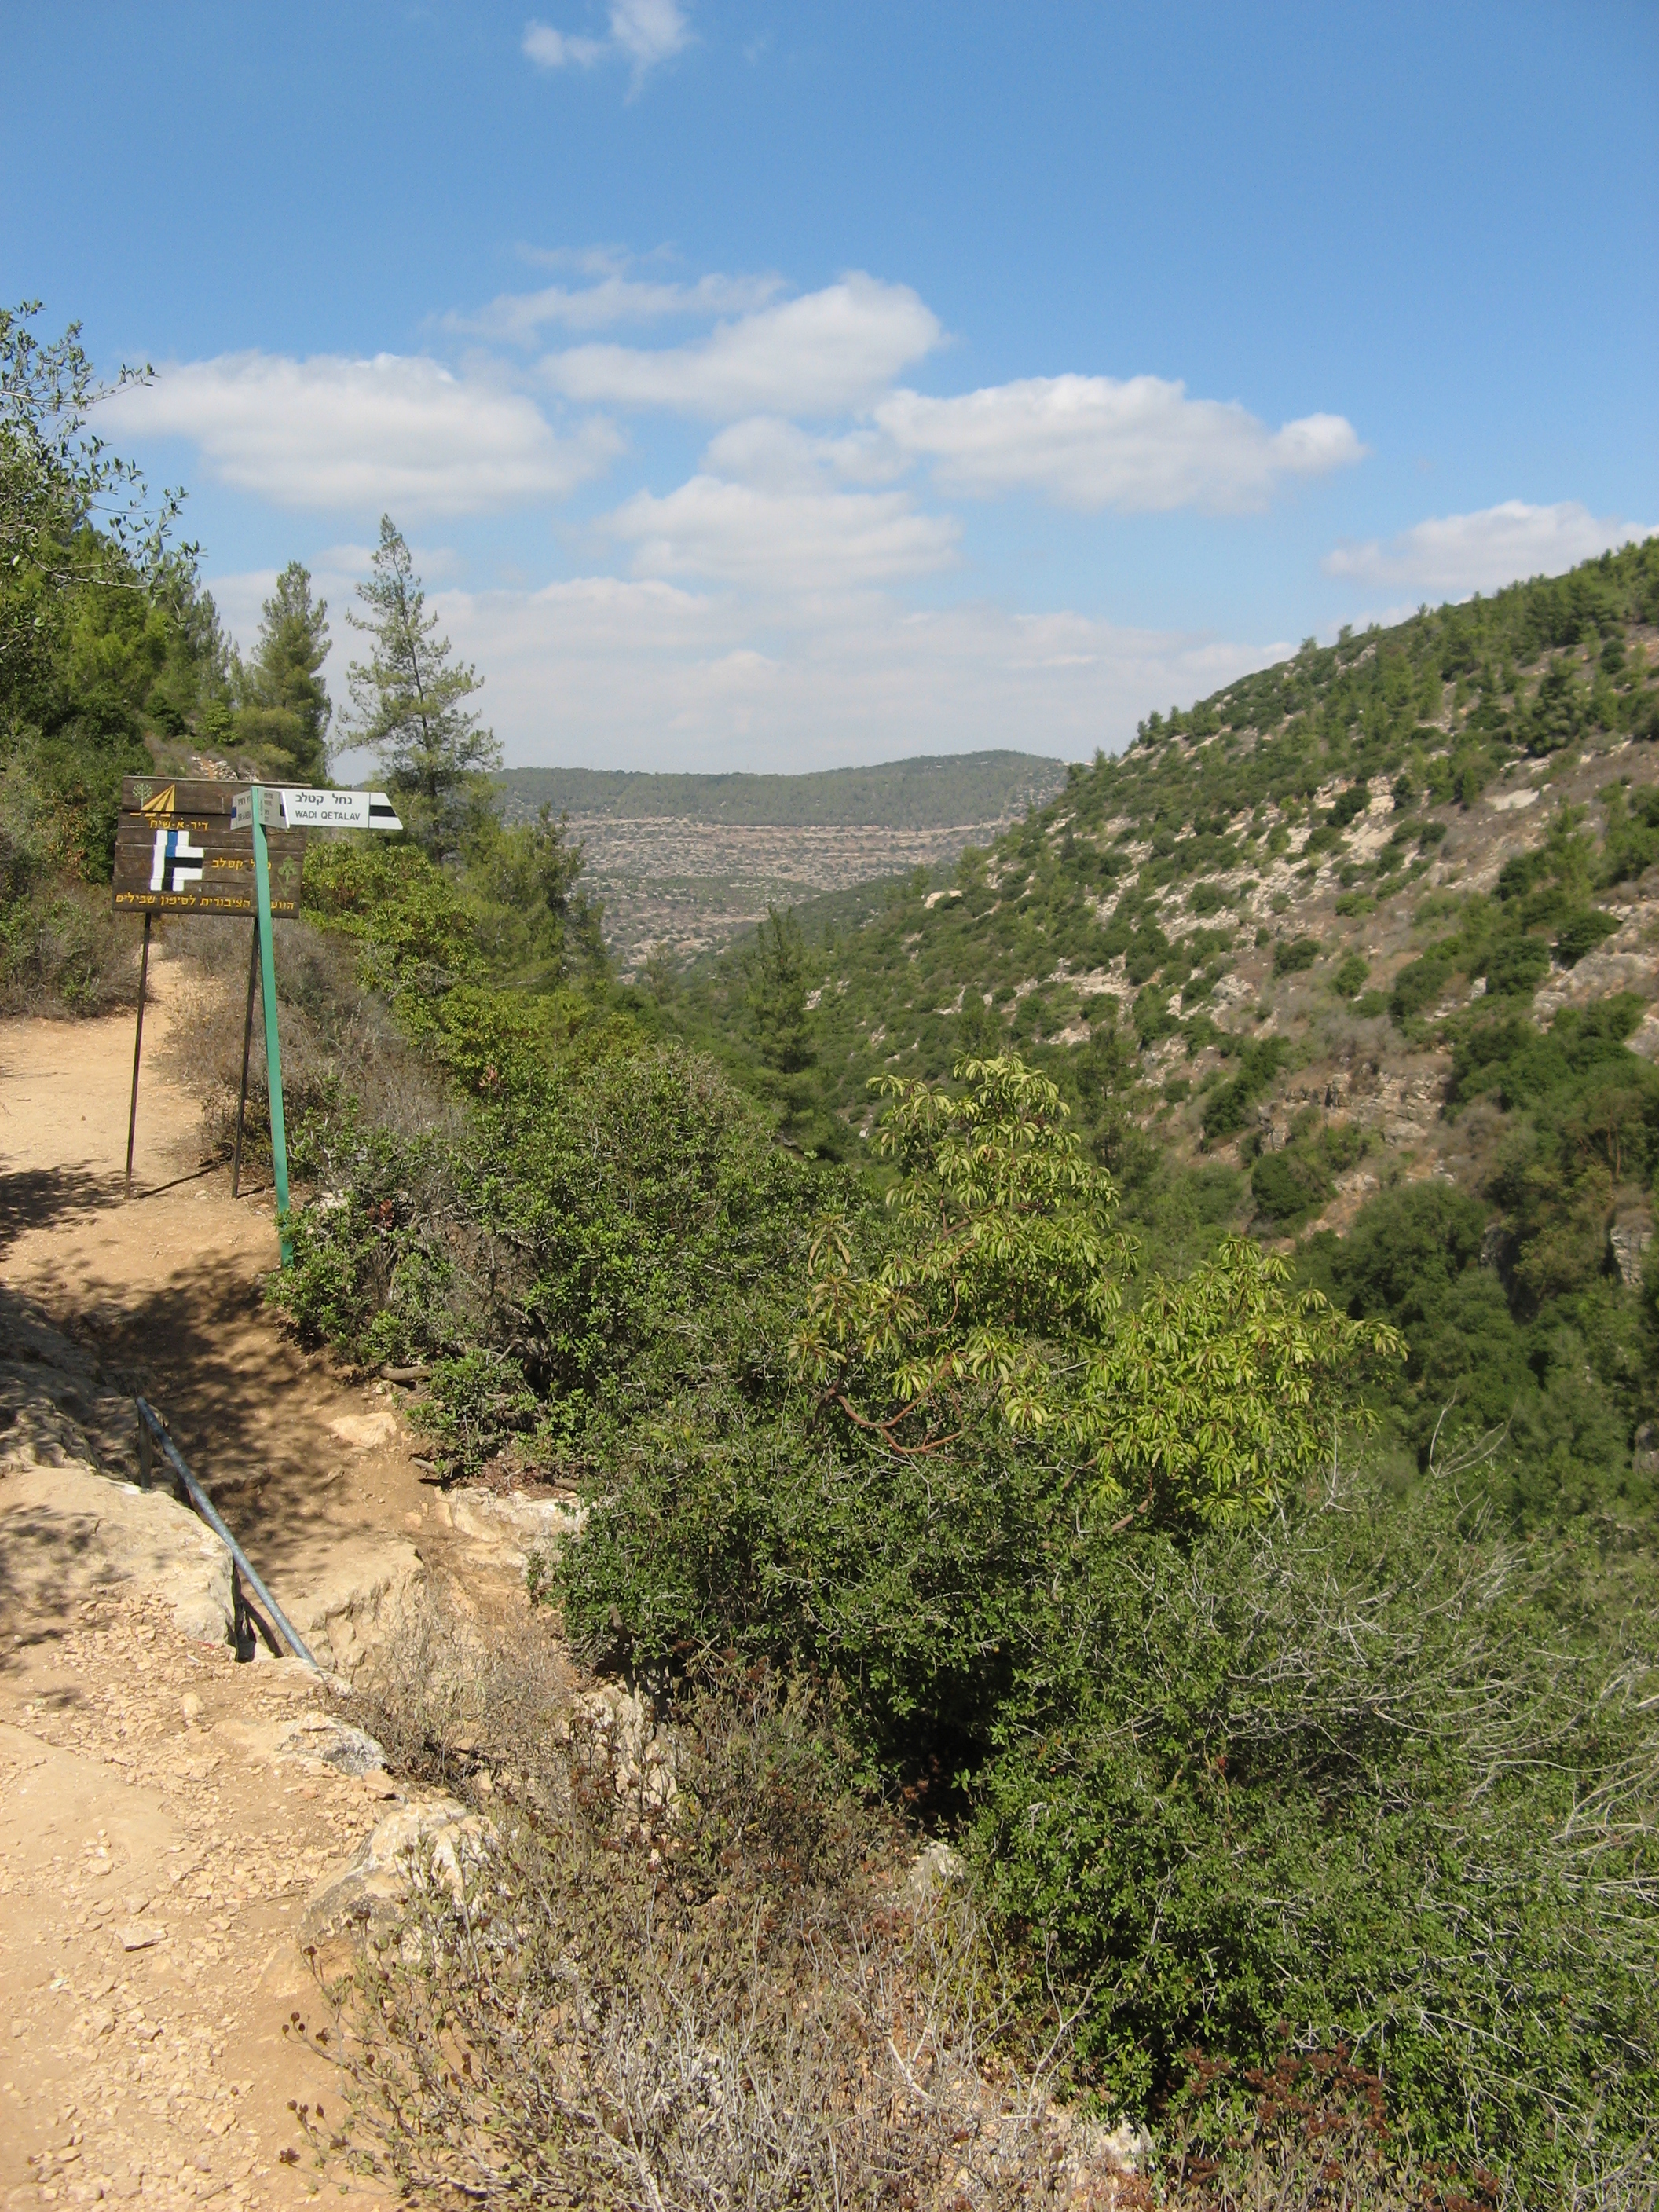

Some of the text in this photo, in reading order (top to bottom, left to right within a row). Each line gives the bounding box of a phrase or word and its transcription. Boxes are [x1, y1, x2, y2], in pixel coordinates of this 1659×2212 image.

[295, 792, 353, 805] נחל קטלב
[295, 810, 361, 821] WADI QETALAV
[211, 857, 244, 870] קטלב
[115, 890, 156, 905] שבילים
[200, 896, 251, 909] הציבורית
